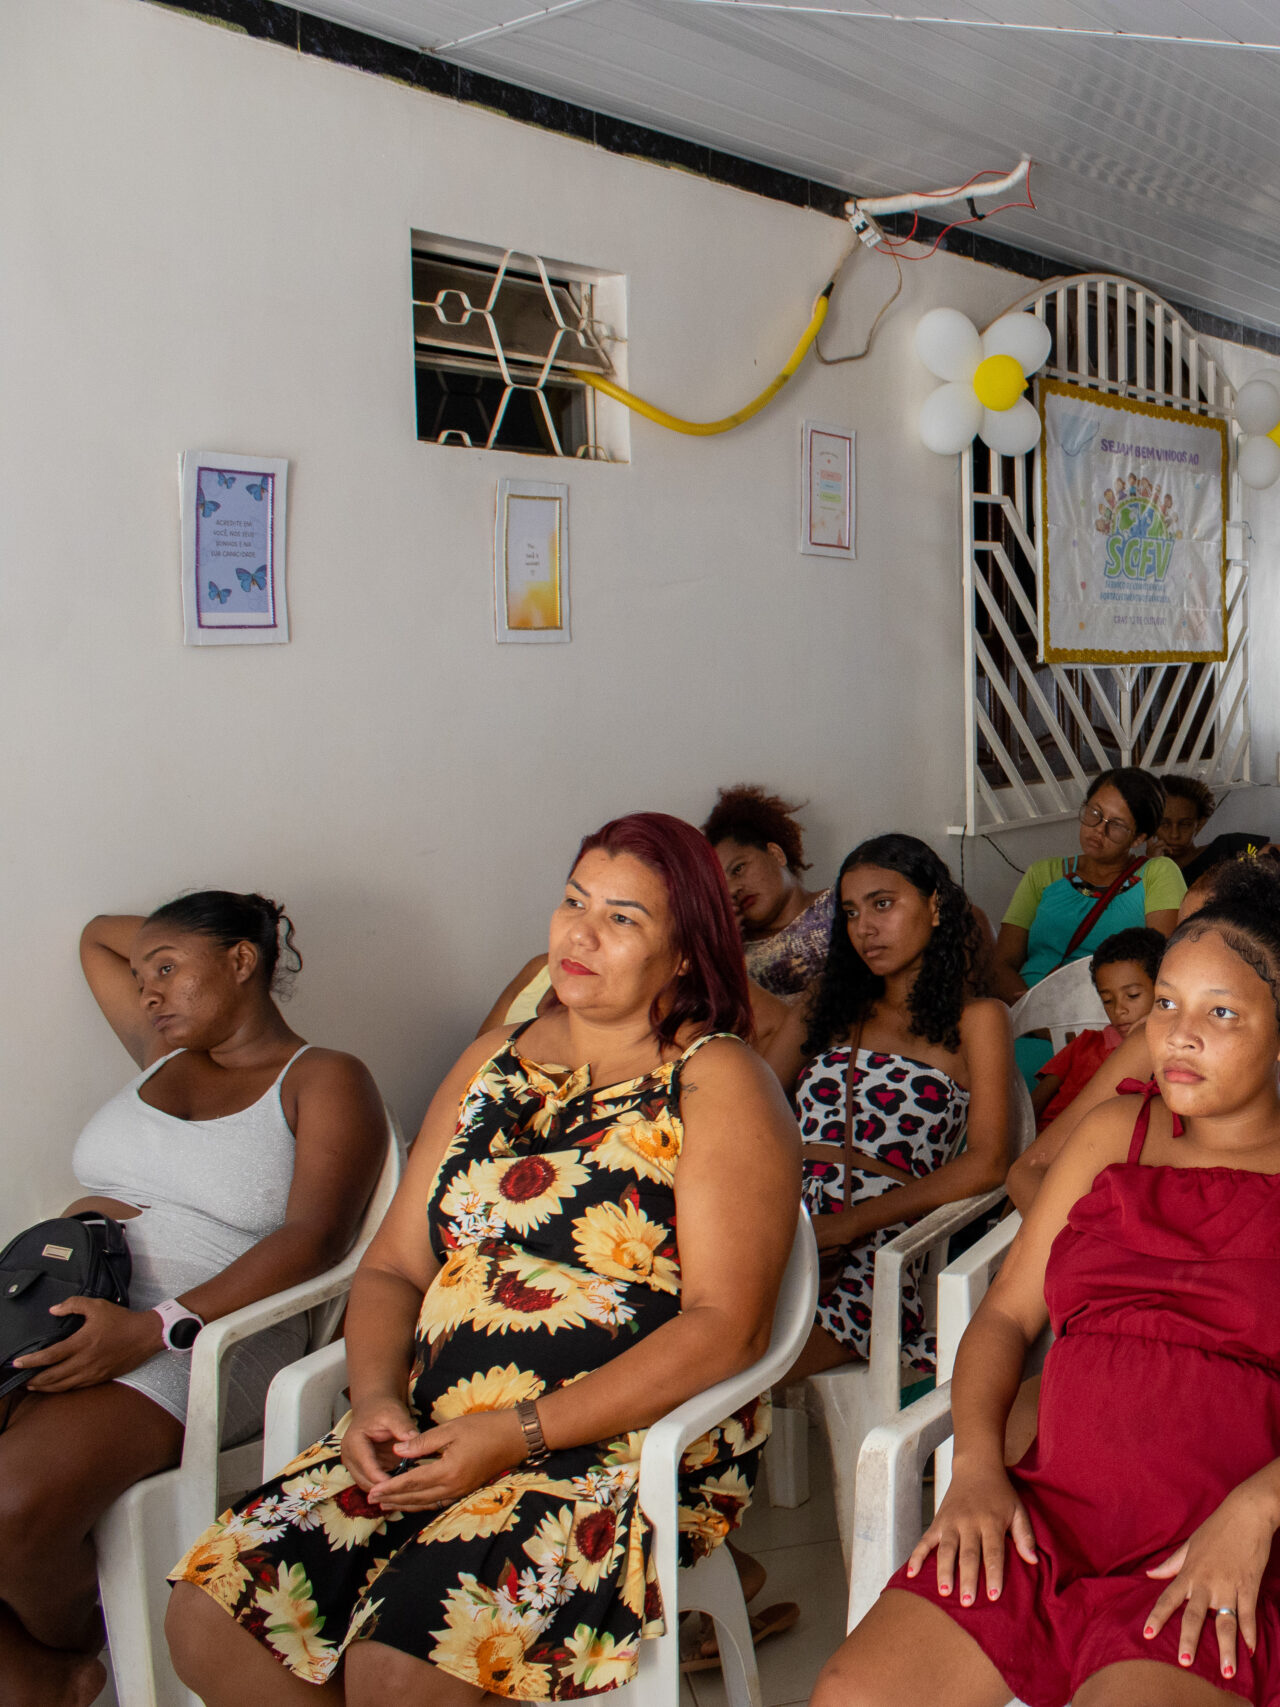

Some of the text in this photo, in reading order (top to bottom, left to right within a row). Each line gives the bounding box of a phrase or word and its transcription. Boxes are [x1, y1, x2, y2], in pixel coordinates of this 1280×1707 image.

[1101, 438, 1199, 465] SEJAM BEM VINDOS AO
[1104, 534, 1174, 581] SCFV
